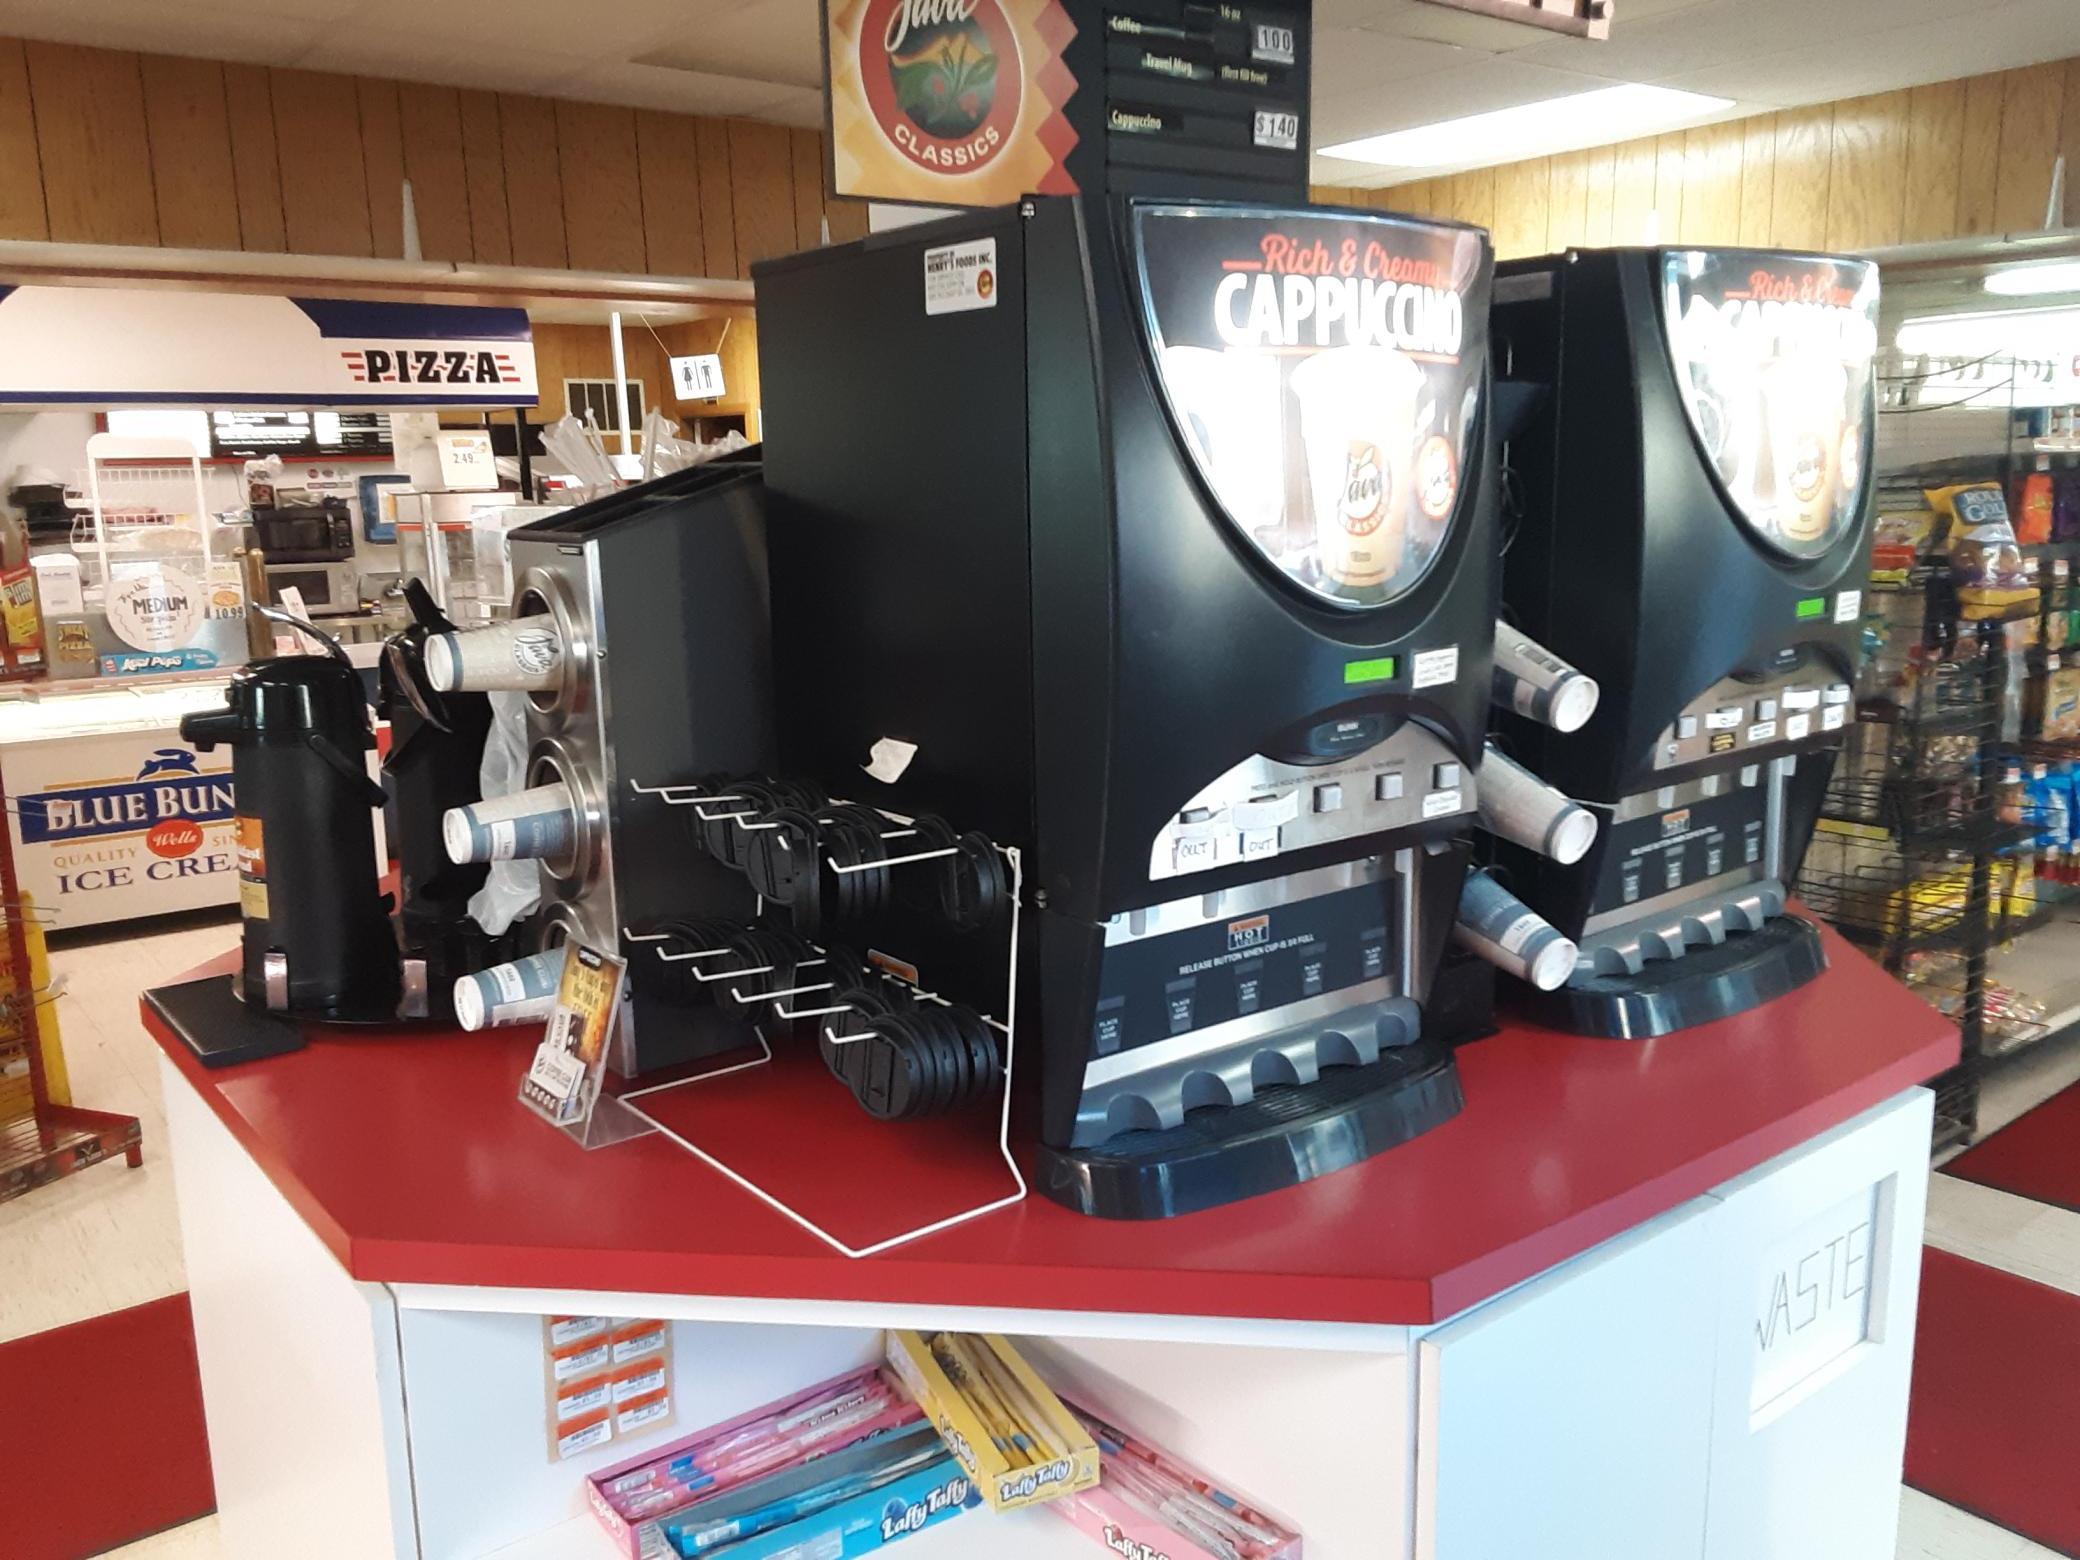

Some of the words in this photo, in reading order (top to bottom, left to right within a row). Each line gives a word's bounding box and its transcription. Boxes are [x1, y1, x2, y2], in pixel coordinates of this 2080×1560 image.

[1112, 16, 1141, 34] Coffee
[1146, 53, 1172, 72] Travel
[1173, 60, 1193, 77] Mug
[1112, 110, 1162, 131] Cappuccino
[895, 124, 1000, 167] CLASSICS
[1260, 233, 1334, 275] Rich
[1338, 239, 1357, 278] &
[1750, 270, 1797, 302] Rich
[1799, 273, 1815, 304] &
[1213, 273, 1463, 356] CAPPUCCINO
[364, 350, 501, 383] PIZZA
[132, 596, 188, 615] MEDIUM
[47, 792, 149, 832] BLUE
[154, 783, 236, 818] BUN
[54, 847, 137, 869] QUALITY
[212, 835, 236, 849] SIN
[152, 830, 198, 848] Wells
[1180, 842, 1208, 856] OUT
[1249, 837, 1272, 852] OUT
[58, 866, 134, 895] ICE
[146, 853, 239, 881] CRE
[1234, 926, 1264, 943] HOT
[1179, 959, 1213, 976] RELEASE
[1213, 952, 1243, 968] BUTTON
[1243, 947, 1264, 961] WHEN
[1755, 1221, 1869, 1352] WASTE
[1000, 1474, 1037, 1503] Laffy
[1035, 1459, 1072, 1487] Taffy
[881, 1503, 927, 1543] Laffy
[924, 1476, 969, 1515] Taffy
